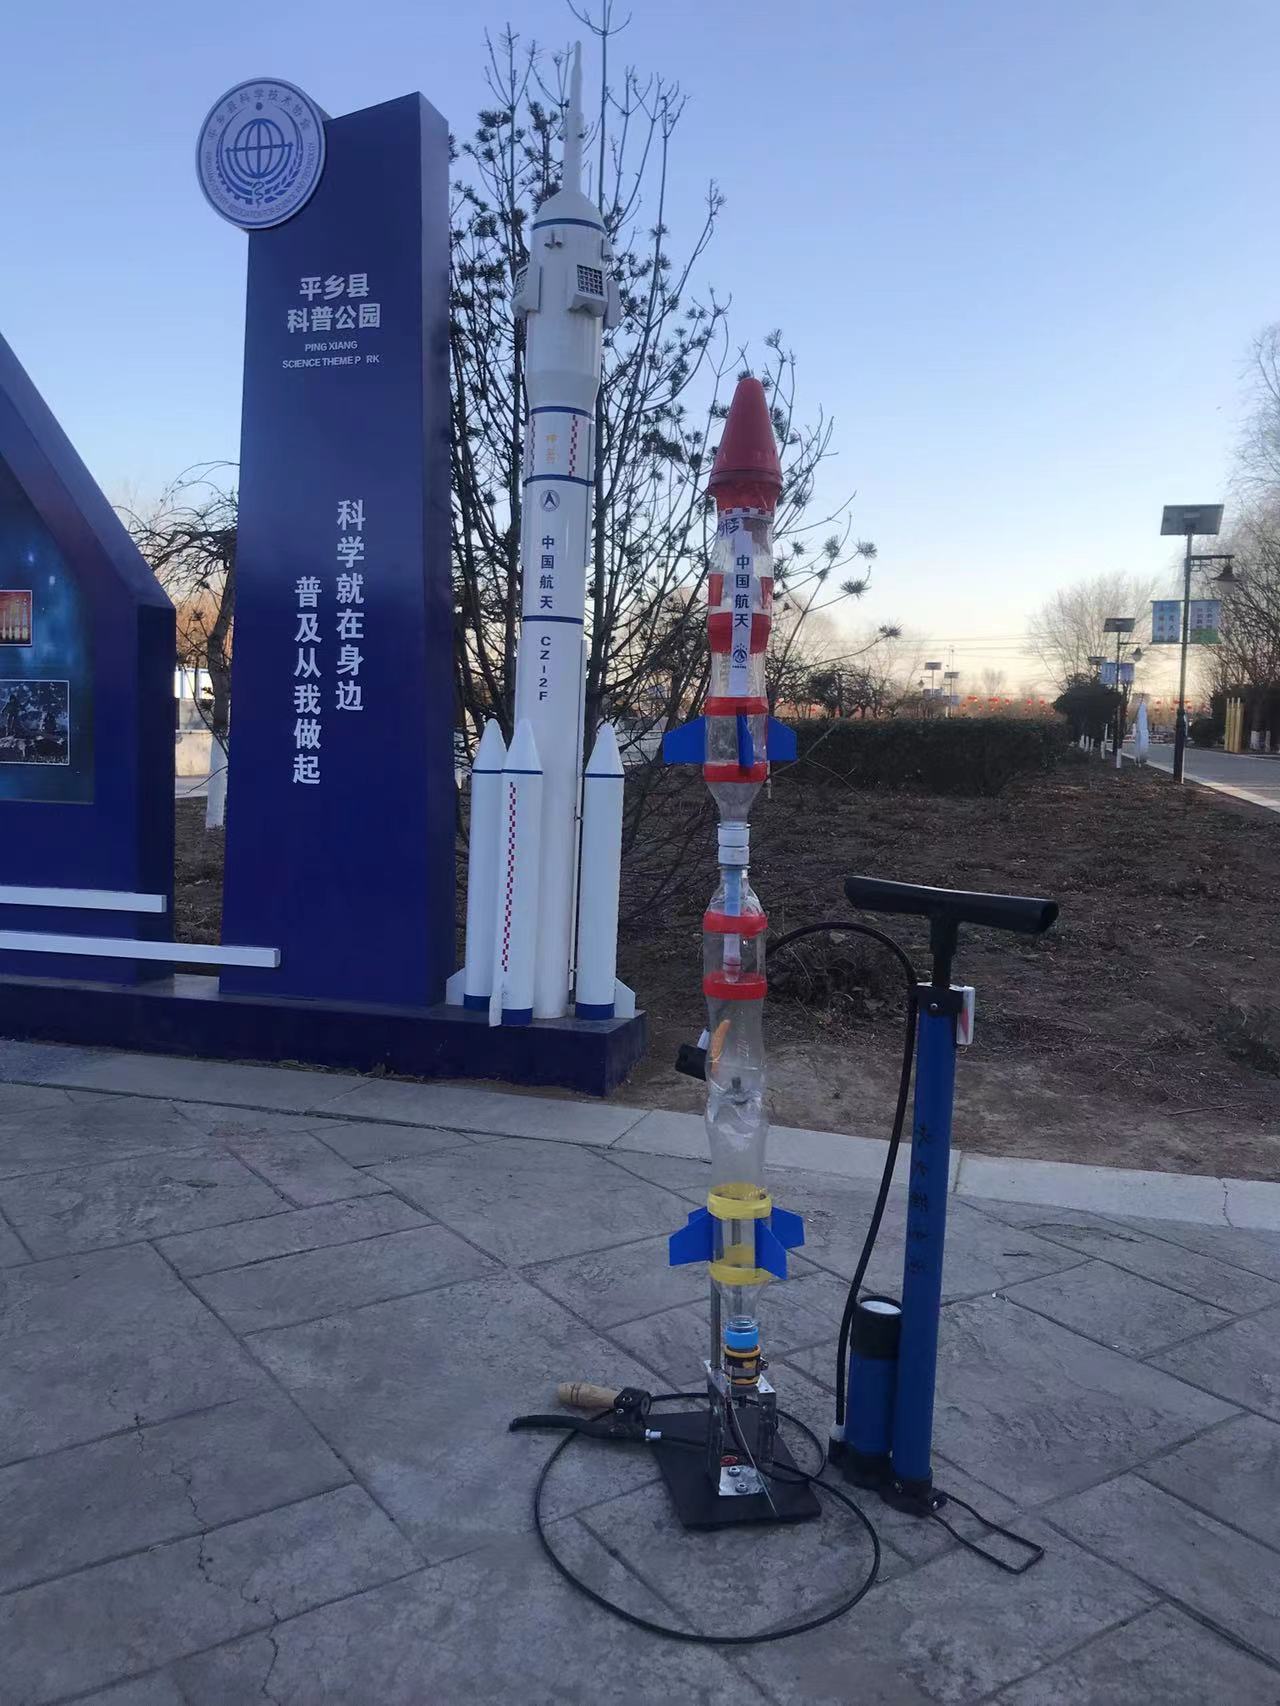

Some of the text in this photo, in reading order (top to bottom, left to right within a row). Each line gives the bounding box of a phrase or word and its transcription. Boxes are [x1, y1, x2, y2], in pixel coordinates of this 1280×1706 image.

[299, 273, 370, 302] 平乡县
[286, 303, 381, 333] 科普公园
[282, 358, 321, 369] SCIENCE
[322, 355, 353, 366] THEME
[304, 340, 358, 352] PING XIANG
[539, 535, 555, 609] 中国航天
[734, 554, 750, 628] 中国航天
[335, 499, 366, 711] 科学就在身边
[293, 576, 322, 785] 普及从我做起
